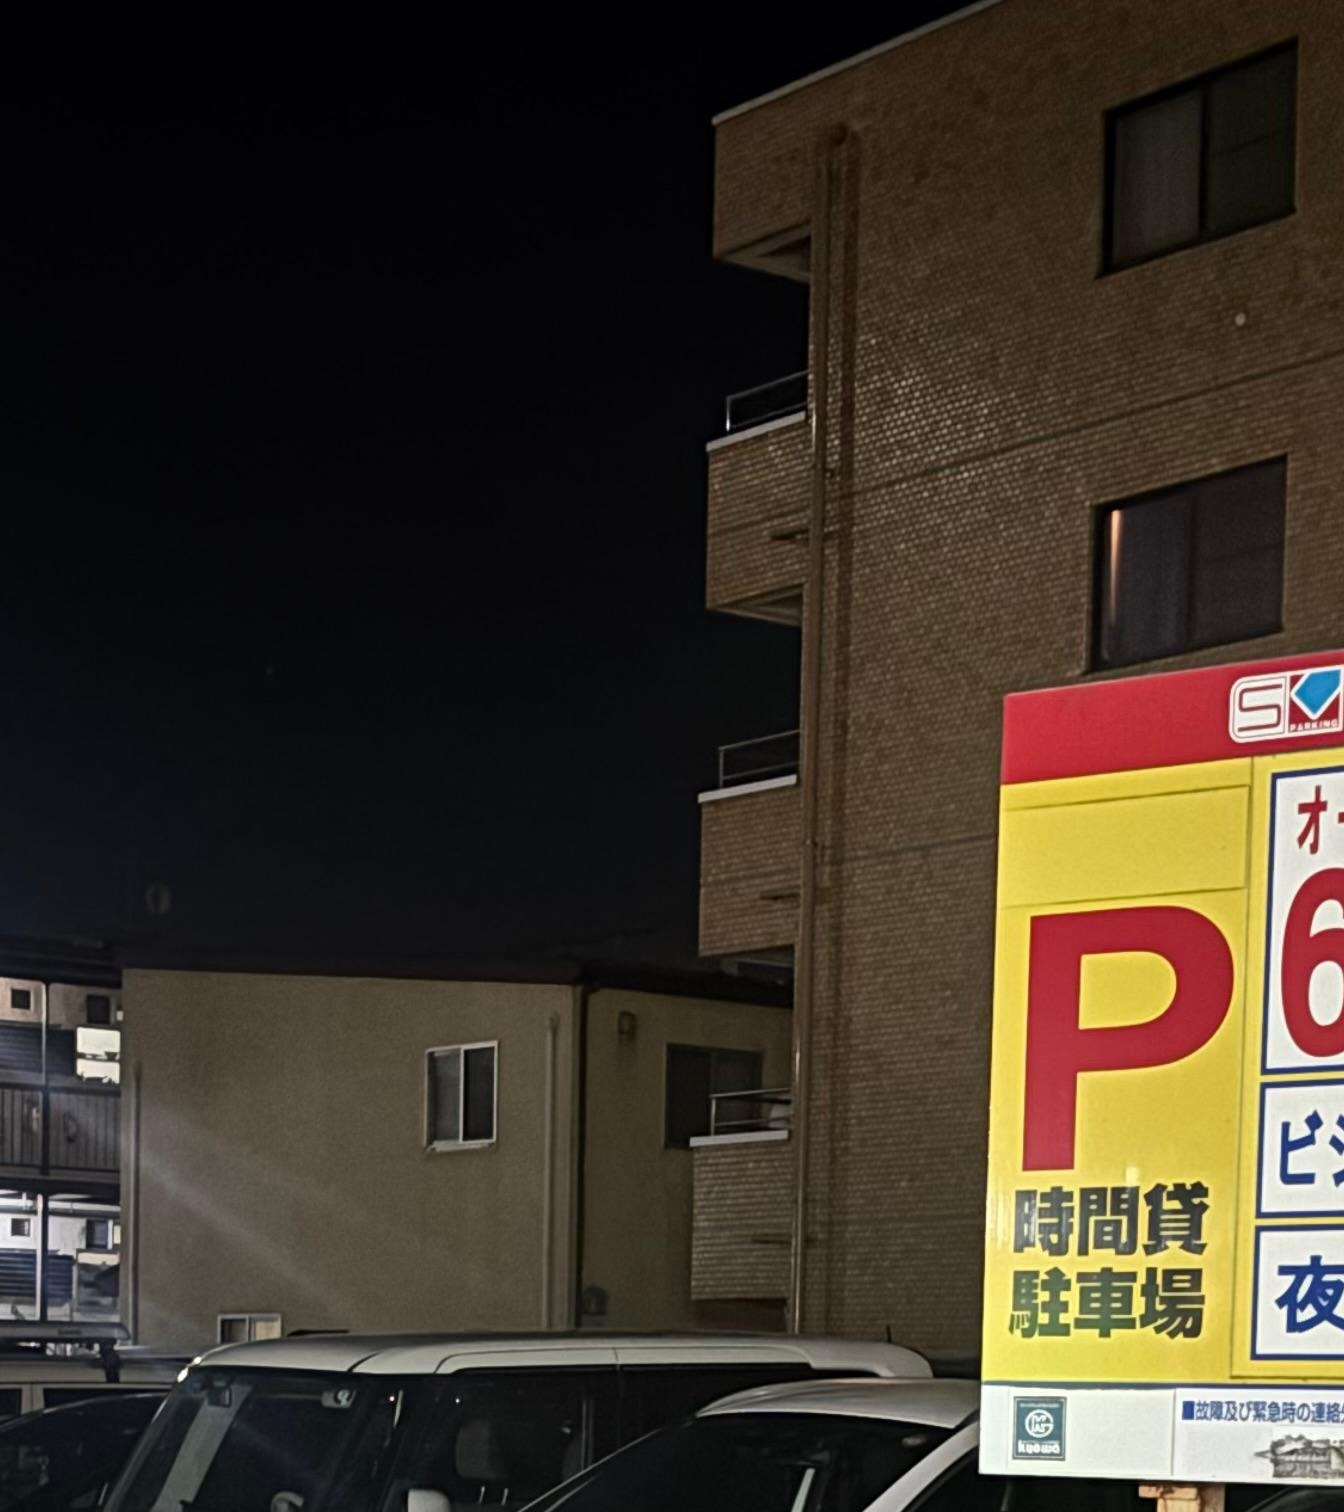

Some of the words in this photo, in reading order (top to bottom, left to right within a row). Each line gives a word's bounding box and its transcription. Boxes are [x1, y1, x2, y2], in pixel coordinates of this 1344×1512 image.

[1290, 718, 1339, 732] PARKING
[1022, 905, 1235, 1171] P
[1013, 1181, 1210, 1257] 時間貸
[1008, 1266, 1206, 1339] 駐車場
